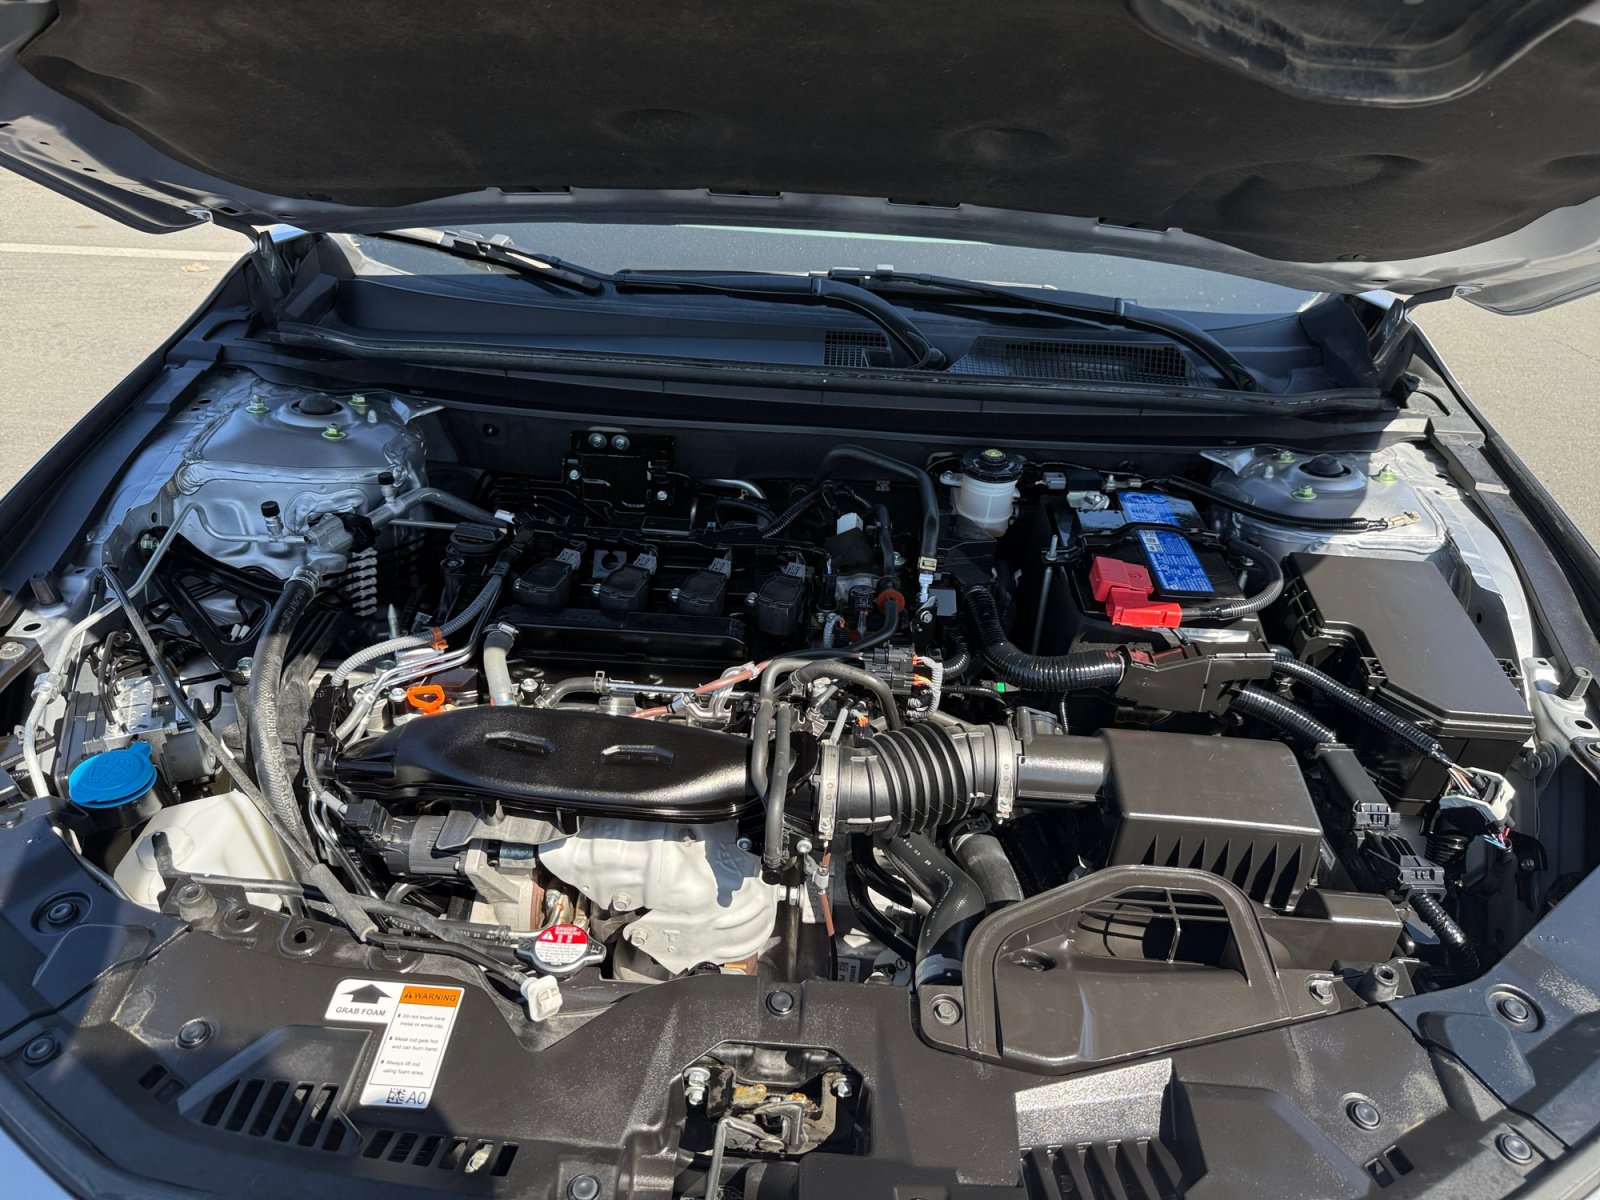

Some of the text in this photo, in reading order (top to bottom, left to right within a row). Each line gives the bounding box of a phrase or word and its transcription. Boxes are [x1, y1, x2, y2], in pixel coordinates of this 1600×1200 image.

[414, 992, 457, 1002] WARNING
[335, 1006, 386, 1016] GRAB FOAM
[405, 1091, 427, 1105] A0
